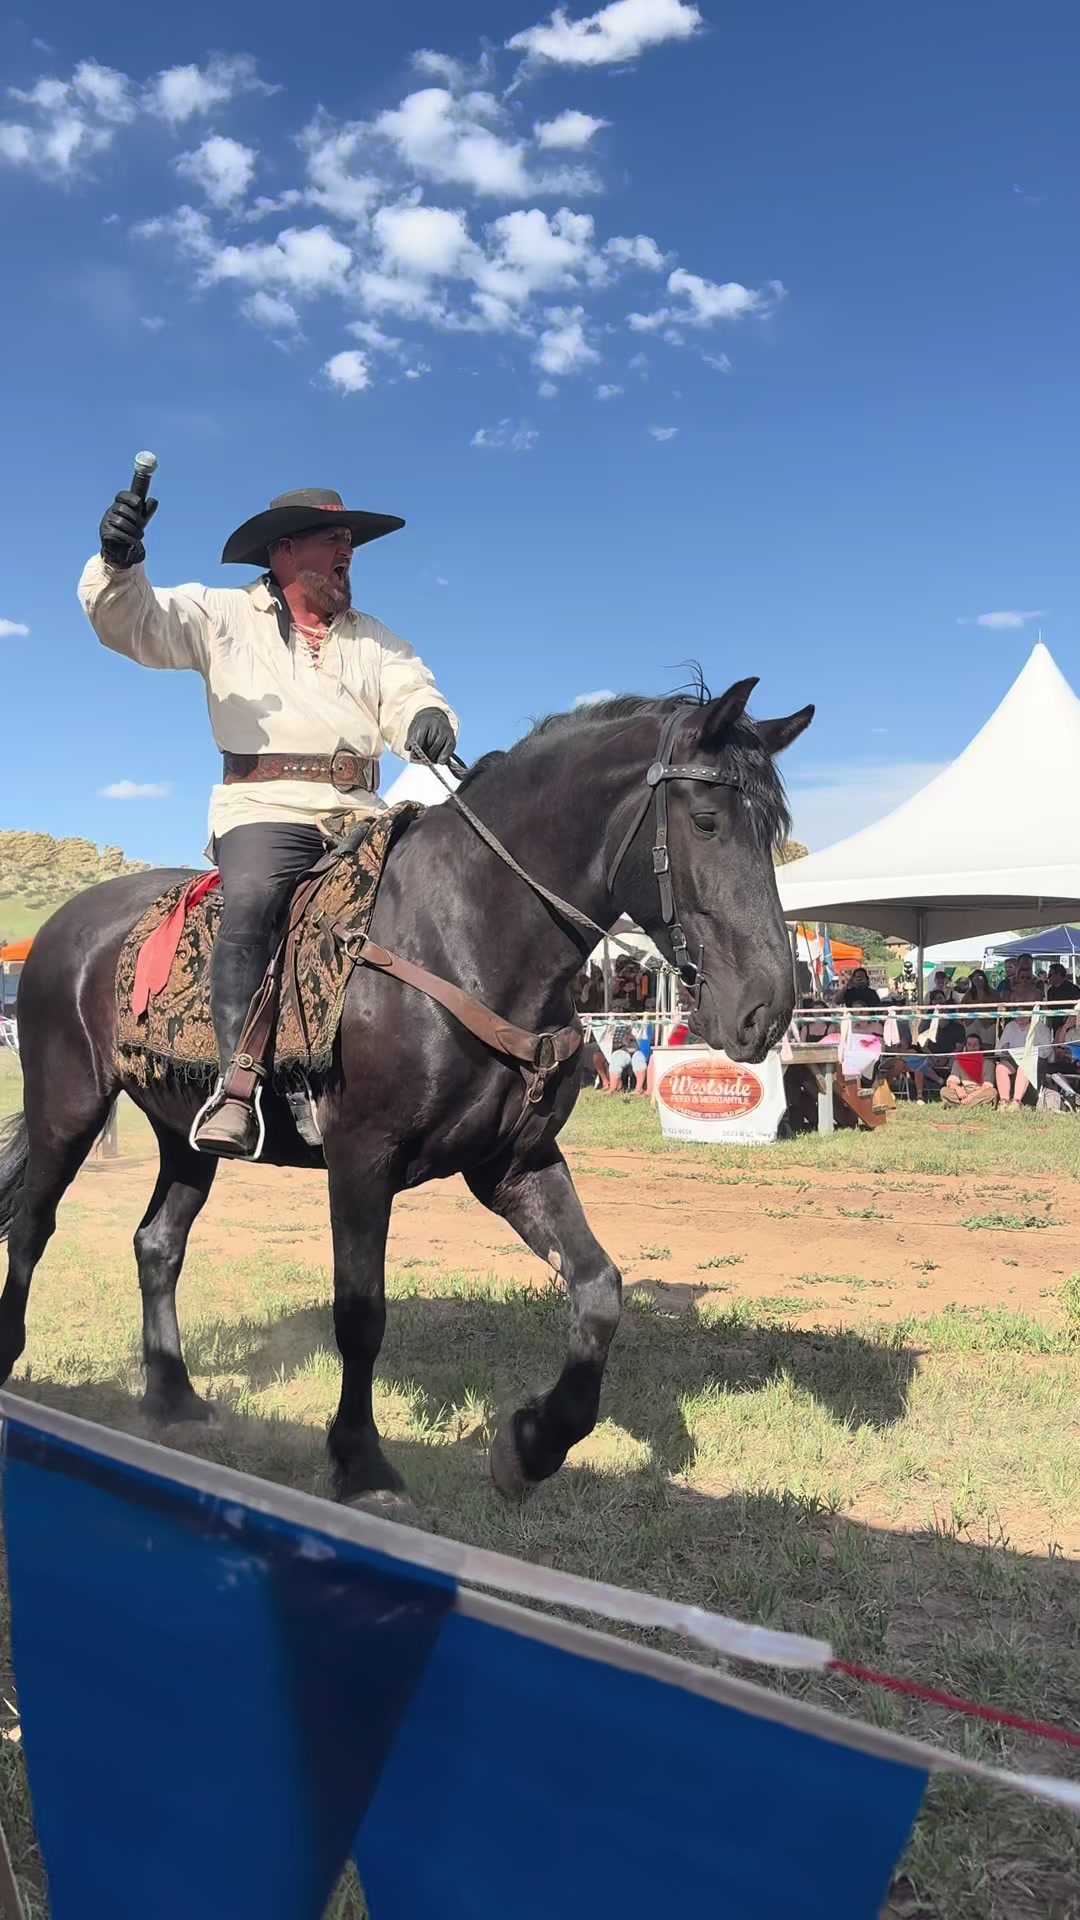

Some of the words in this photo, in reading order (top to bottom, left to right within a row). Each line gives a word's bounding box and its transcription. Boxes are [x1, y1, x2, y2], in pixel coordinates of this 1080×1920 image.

[669, 1075, 751, 1096] Westside
[671, 1095, 691, 1103] FEED
[700, 1096, 751, 1105] MERCANTILE
